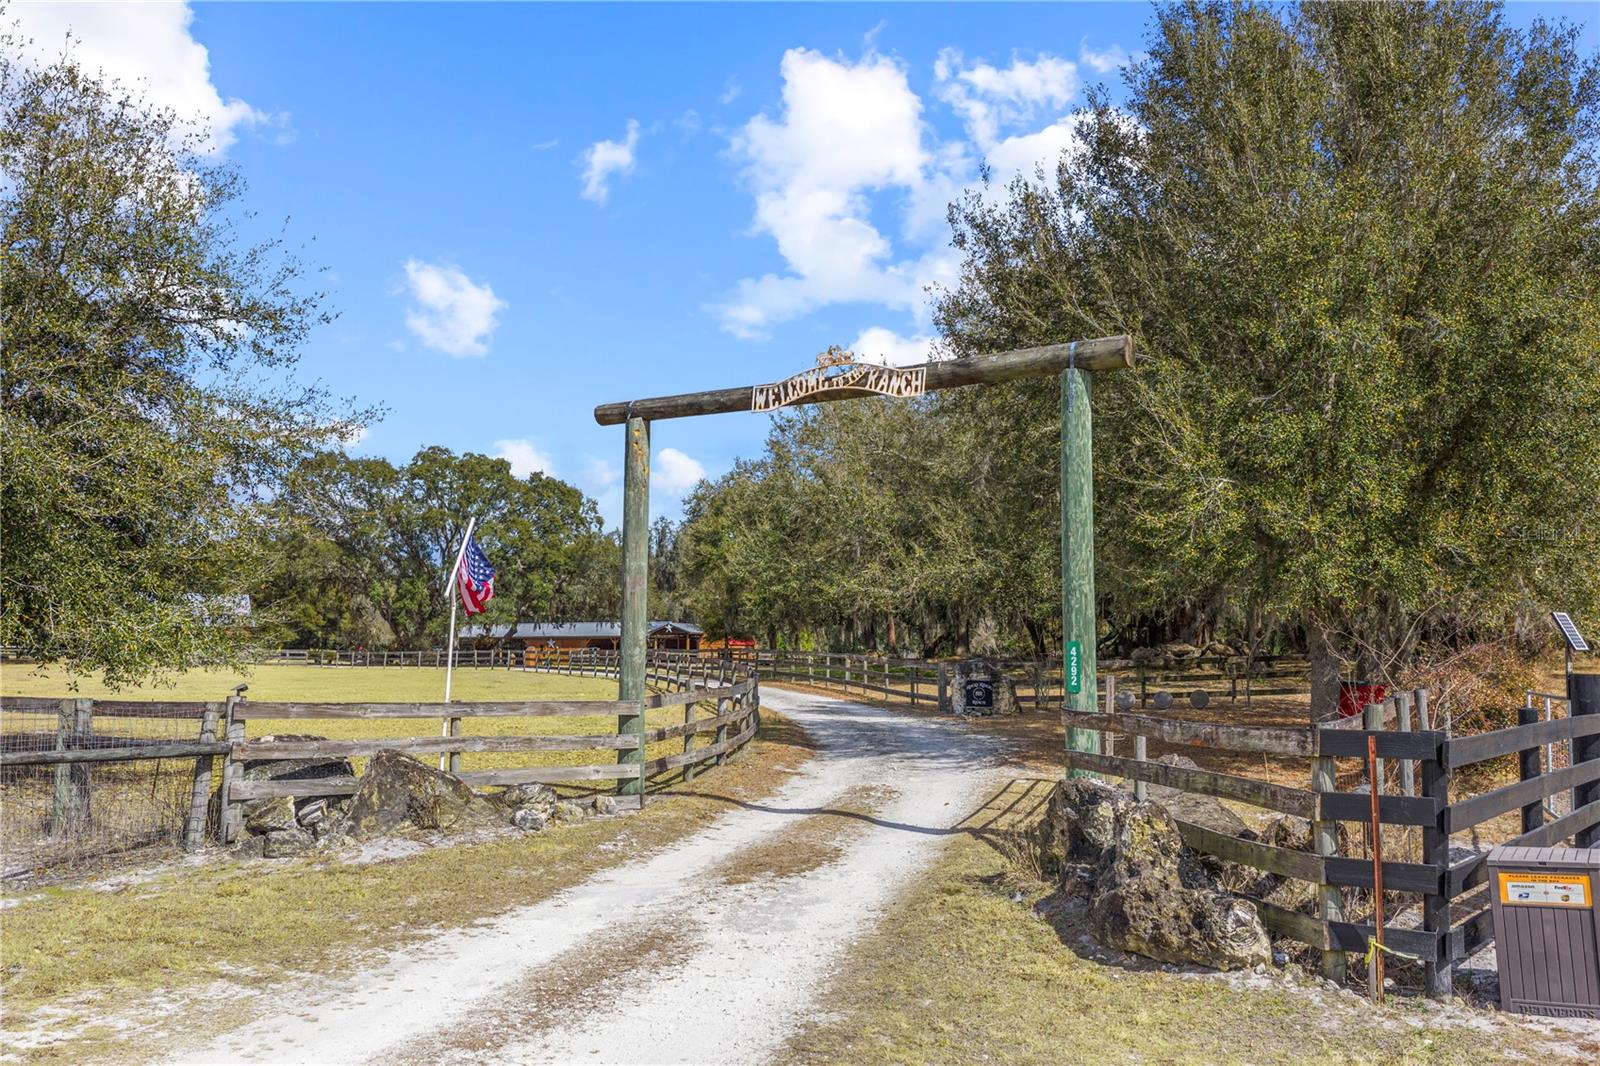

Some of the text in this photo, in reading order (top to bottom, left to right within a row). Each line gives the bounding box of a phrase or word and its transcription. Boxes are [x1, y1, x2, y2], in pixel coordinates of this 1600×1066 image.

[755, 367, 829, 410] WELCOME
[832, 377, 844, 388] TO
[865, 369, 924, 397] RANCH
[1070, 646, 1078, 686] 4292
[1519, 1003, 1596, 1019] DELIVERIES
